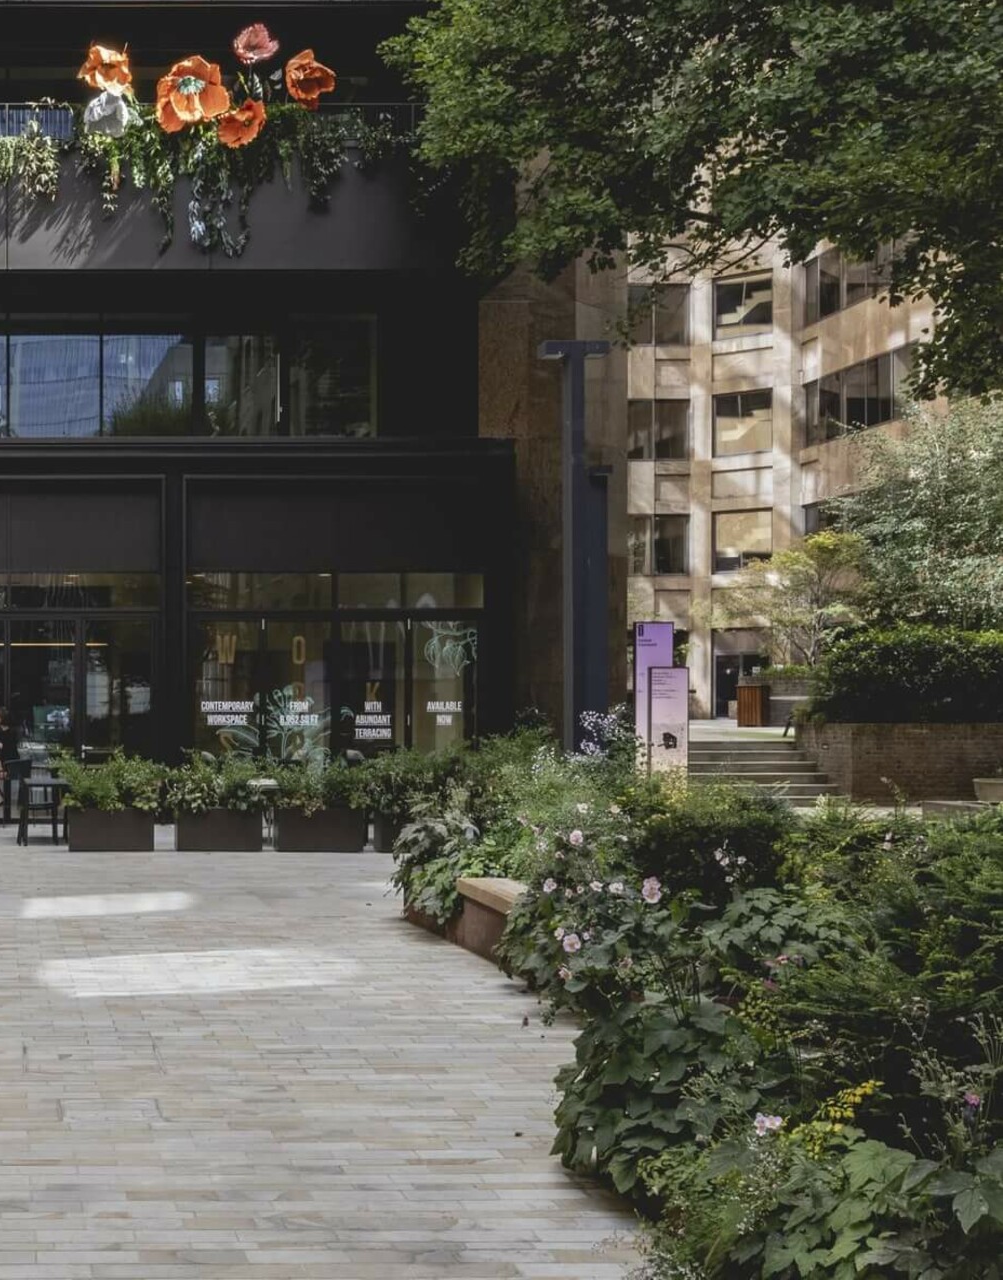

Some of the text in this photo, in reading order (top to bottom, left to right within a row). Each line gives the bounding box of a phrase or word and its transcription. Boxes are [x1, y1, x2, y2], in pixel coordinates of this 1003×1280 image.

[201, 701, 254, 712] CONTEMPORARY
[289, 701, 309, 712] FROM
[364, 701, 382, 712] WITH
[426, 701, 462, 712] AVAILABLE
[207, 714, 248, 725] WORKSPACE
[355, 714, 391, 726] ABUNDANT
[436, 714, 453, 725] NOW
[354, 728, 392, 739] TERRACING
